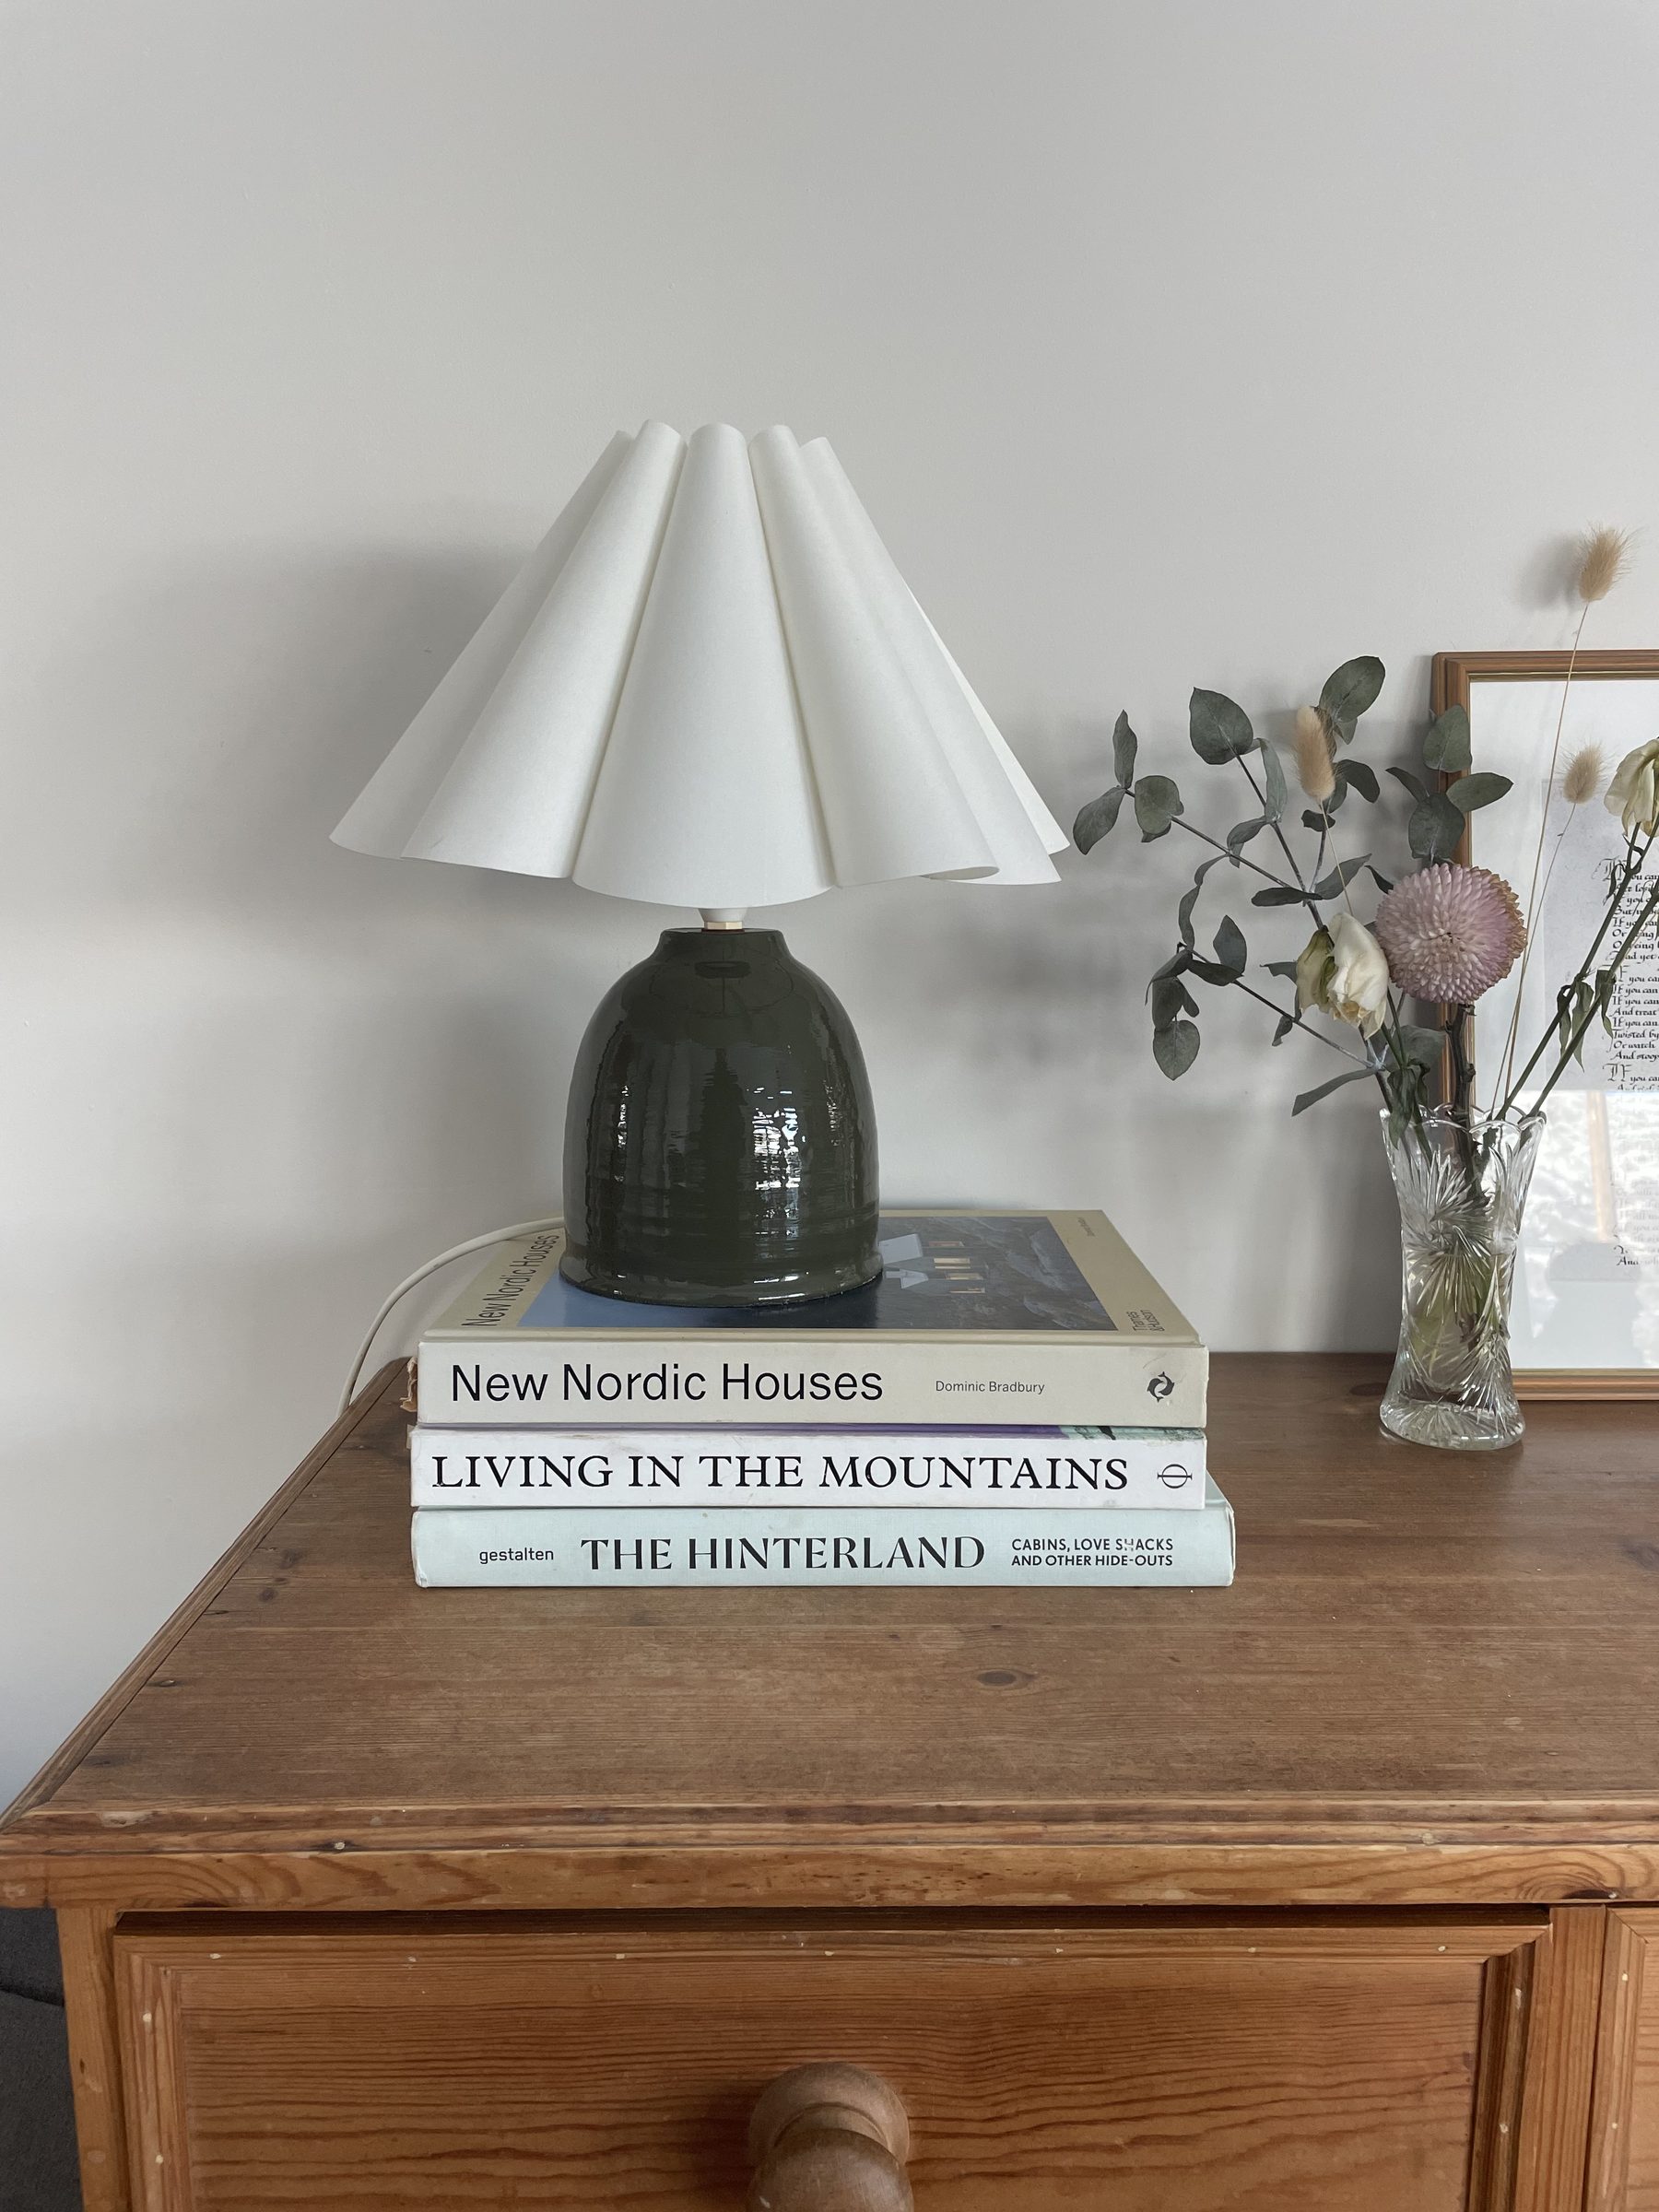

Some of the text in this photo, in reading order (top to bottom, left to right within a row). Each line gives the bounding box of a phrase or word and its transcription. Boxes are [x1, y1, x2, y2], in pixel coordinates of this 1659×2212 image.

[1612, 940, 1623, 949] O
[461, 1234, 560, 1326] New Nordic Houses
[453, 1361, 883, 1402] New Nordic Houses
[935, 1381, 1045, 1395] Dominic Bradbury
[431, 1455, 1128, 1490] LIVING IN THE MOUNTAINS
[581, 1536, 984, 1570] THE HINTERLAND
[1011, 1538, 1173, 1552] CABINS, LOVE SHACKS
[479, 1547, 554, 1565] gestalten
[1011, 1555, 1173, 1566] AND OTHER HIDE-OUTS
